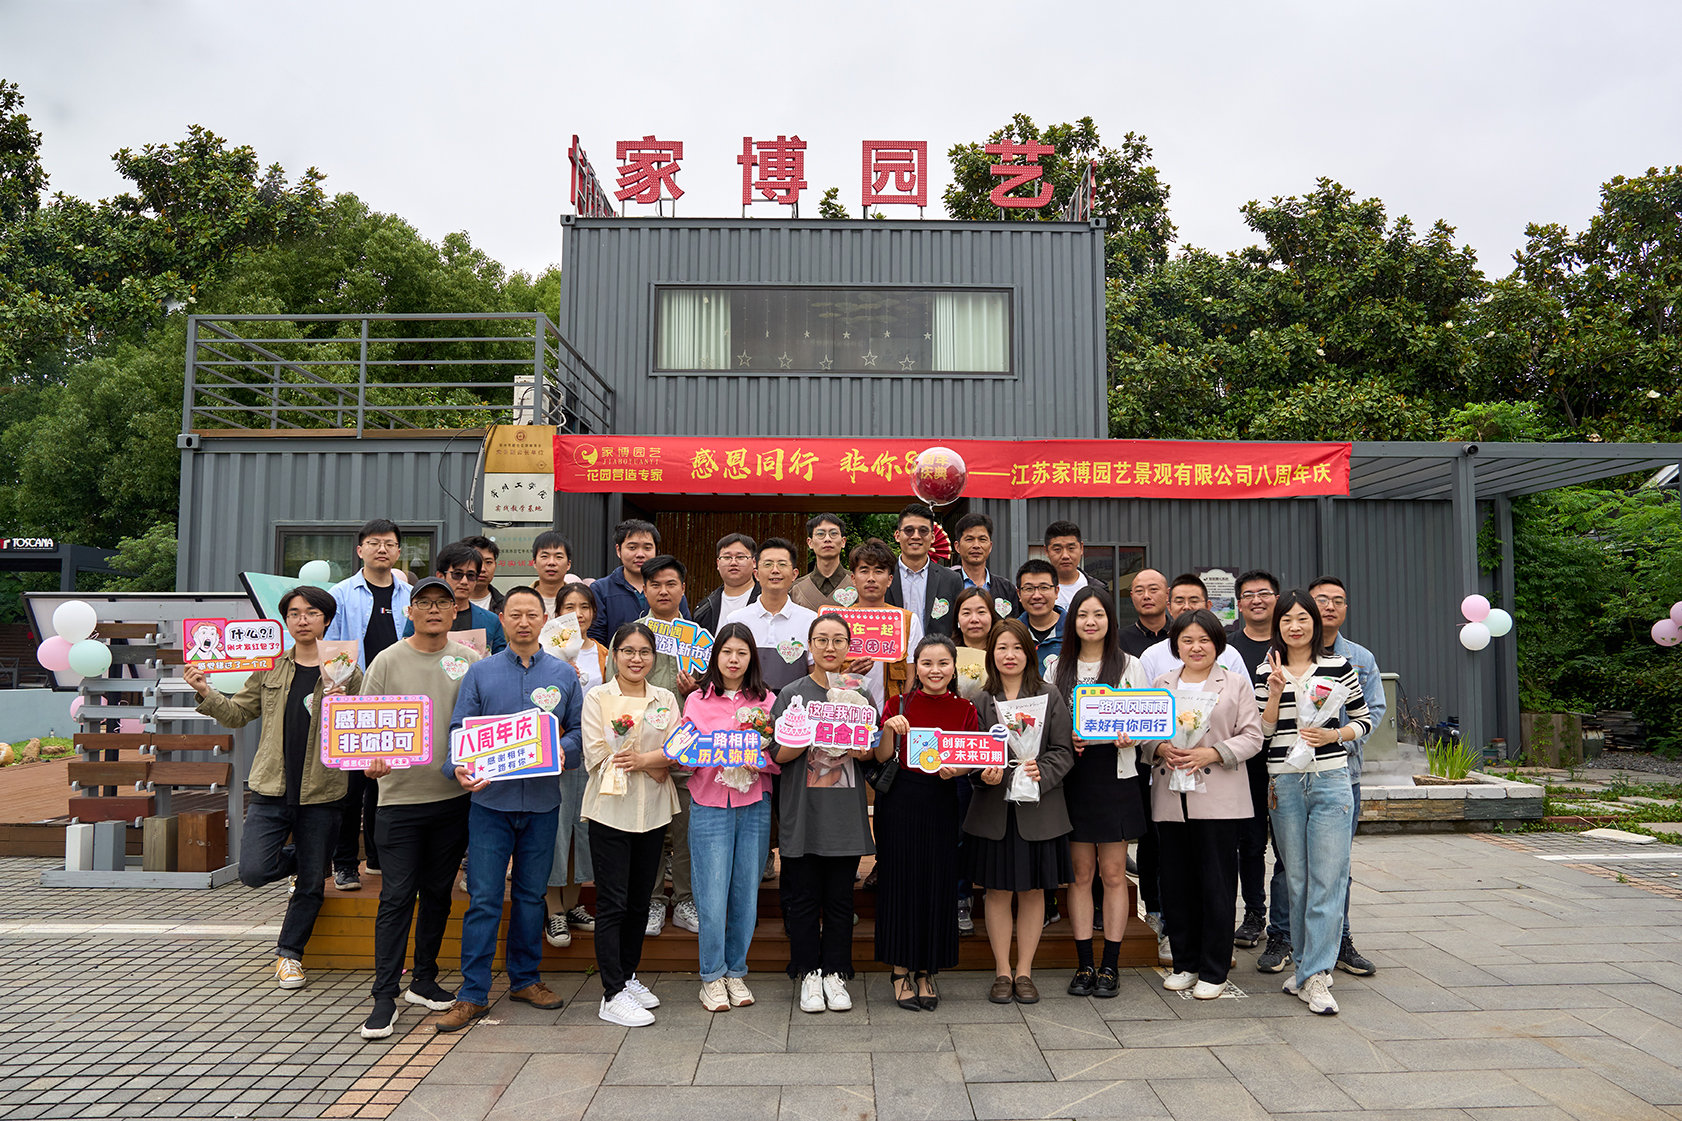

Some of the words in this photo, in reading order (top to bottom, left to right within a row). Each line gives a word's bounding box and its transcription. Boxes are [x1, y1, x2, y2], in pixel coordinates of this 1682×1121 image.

[614, 135, 1055, 209] 家博园艺
[601, 446, 661, 458] 家博园艺
[690, 447, 820, 481] 感恩同行
[839, 449, 919, 484] 非你8
[920, 465, 948, 480] 庆典
[12, 537, 54, 547] TOSCANA
[647, 620, 683, 639] 新机遇
[847, 622, 894, 637] 在一起
[808, 702, 875, 725] 这是我们的
[1085, 699, 1169, 715] 一路风风雨雨
[334, 708, 419, 730] 感恩同行
[1084, 718, 1168, 733] 幸好有你同行
[338, 730, 414, 753] 非你8可
[458, 716, 532, 757] 八周年庆
[698, 732, 759, 748] 一路相伴
[814, 721, 871, 747] 纪念日
[942, 736, 990, 749] 创新不止
[487, 747, 526, 766] 感谢相伴
[697, 748, 759, 765] 历久弥新
[954, 749, 1003, 763] 未来可期
[488, 757, 527, 773] 一路有你
